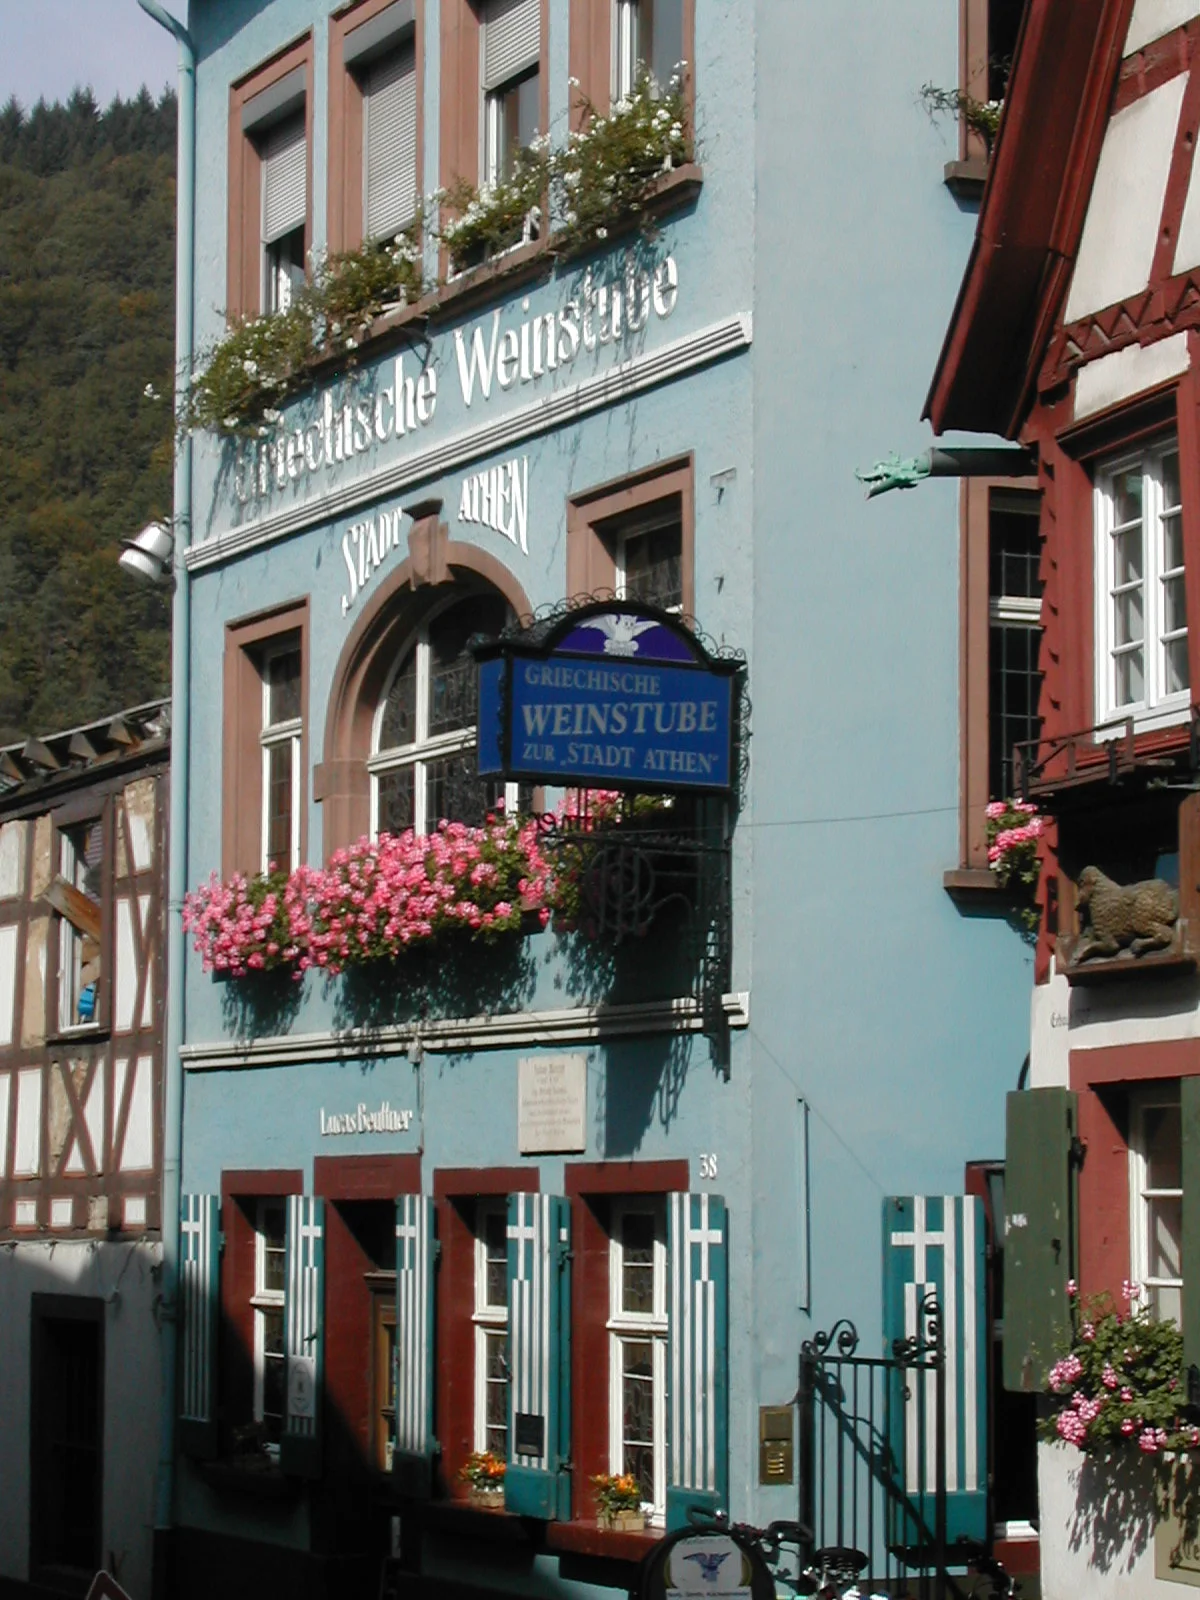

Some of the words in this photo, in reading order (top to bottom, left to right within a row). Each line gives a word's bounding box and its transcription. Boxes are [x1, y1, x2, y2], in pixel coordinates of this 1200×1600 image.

[453, 249, 679, 407] Weinstube
[340, 506, 402, 617] STADT
[457, 455, 529, 555] ATHEN
[525, 664, 661, 695] GRIECHISCHE
[521, 701, 718, 737] WEINSTUBE
[522, 743, 555, 763] ZUR
